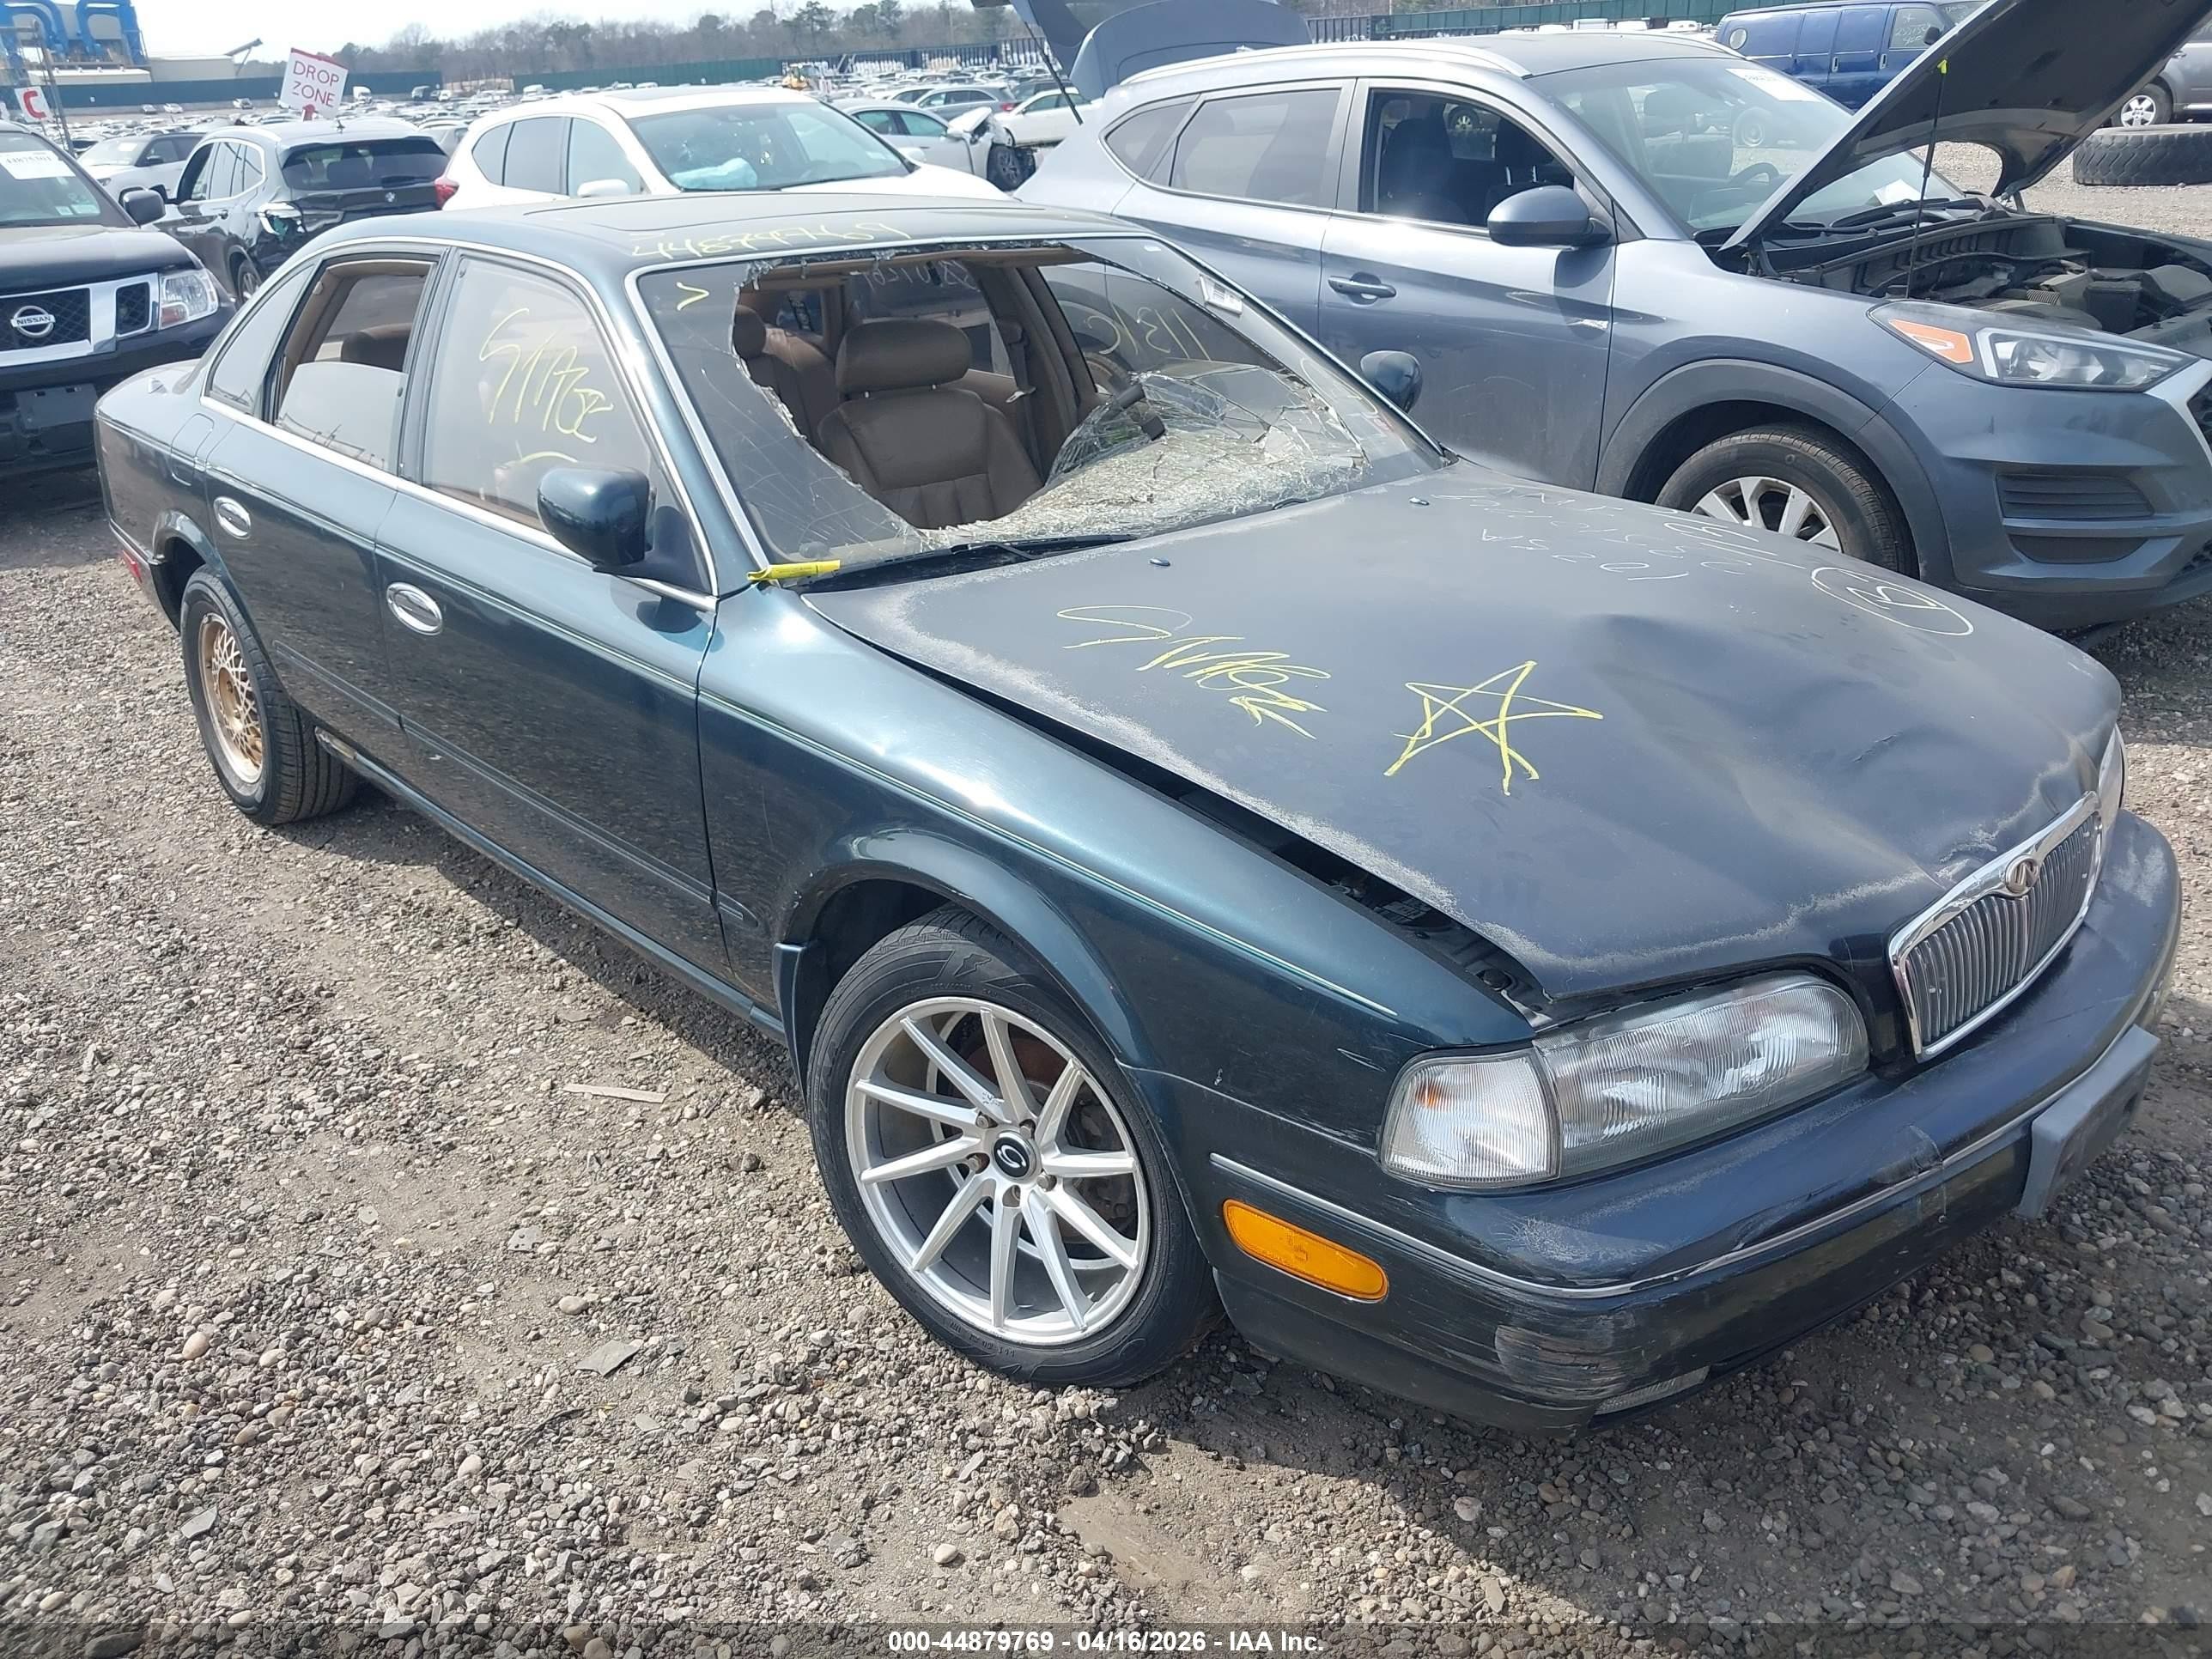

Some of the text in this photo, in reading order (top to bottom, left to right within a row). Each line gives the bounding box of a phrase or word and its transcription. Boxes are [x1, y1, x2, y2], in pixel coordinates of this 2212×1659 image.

[293, 60, 339, 87] DROP
[23, 90, 47, 119] C
[292, 81, 336, 108] ZONE
[16, 316, 52, 325] NISSAN
